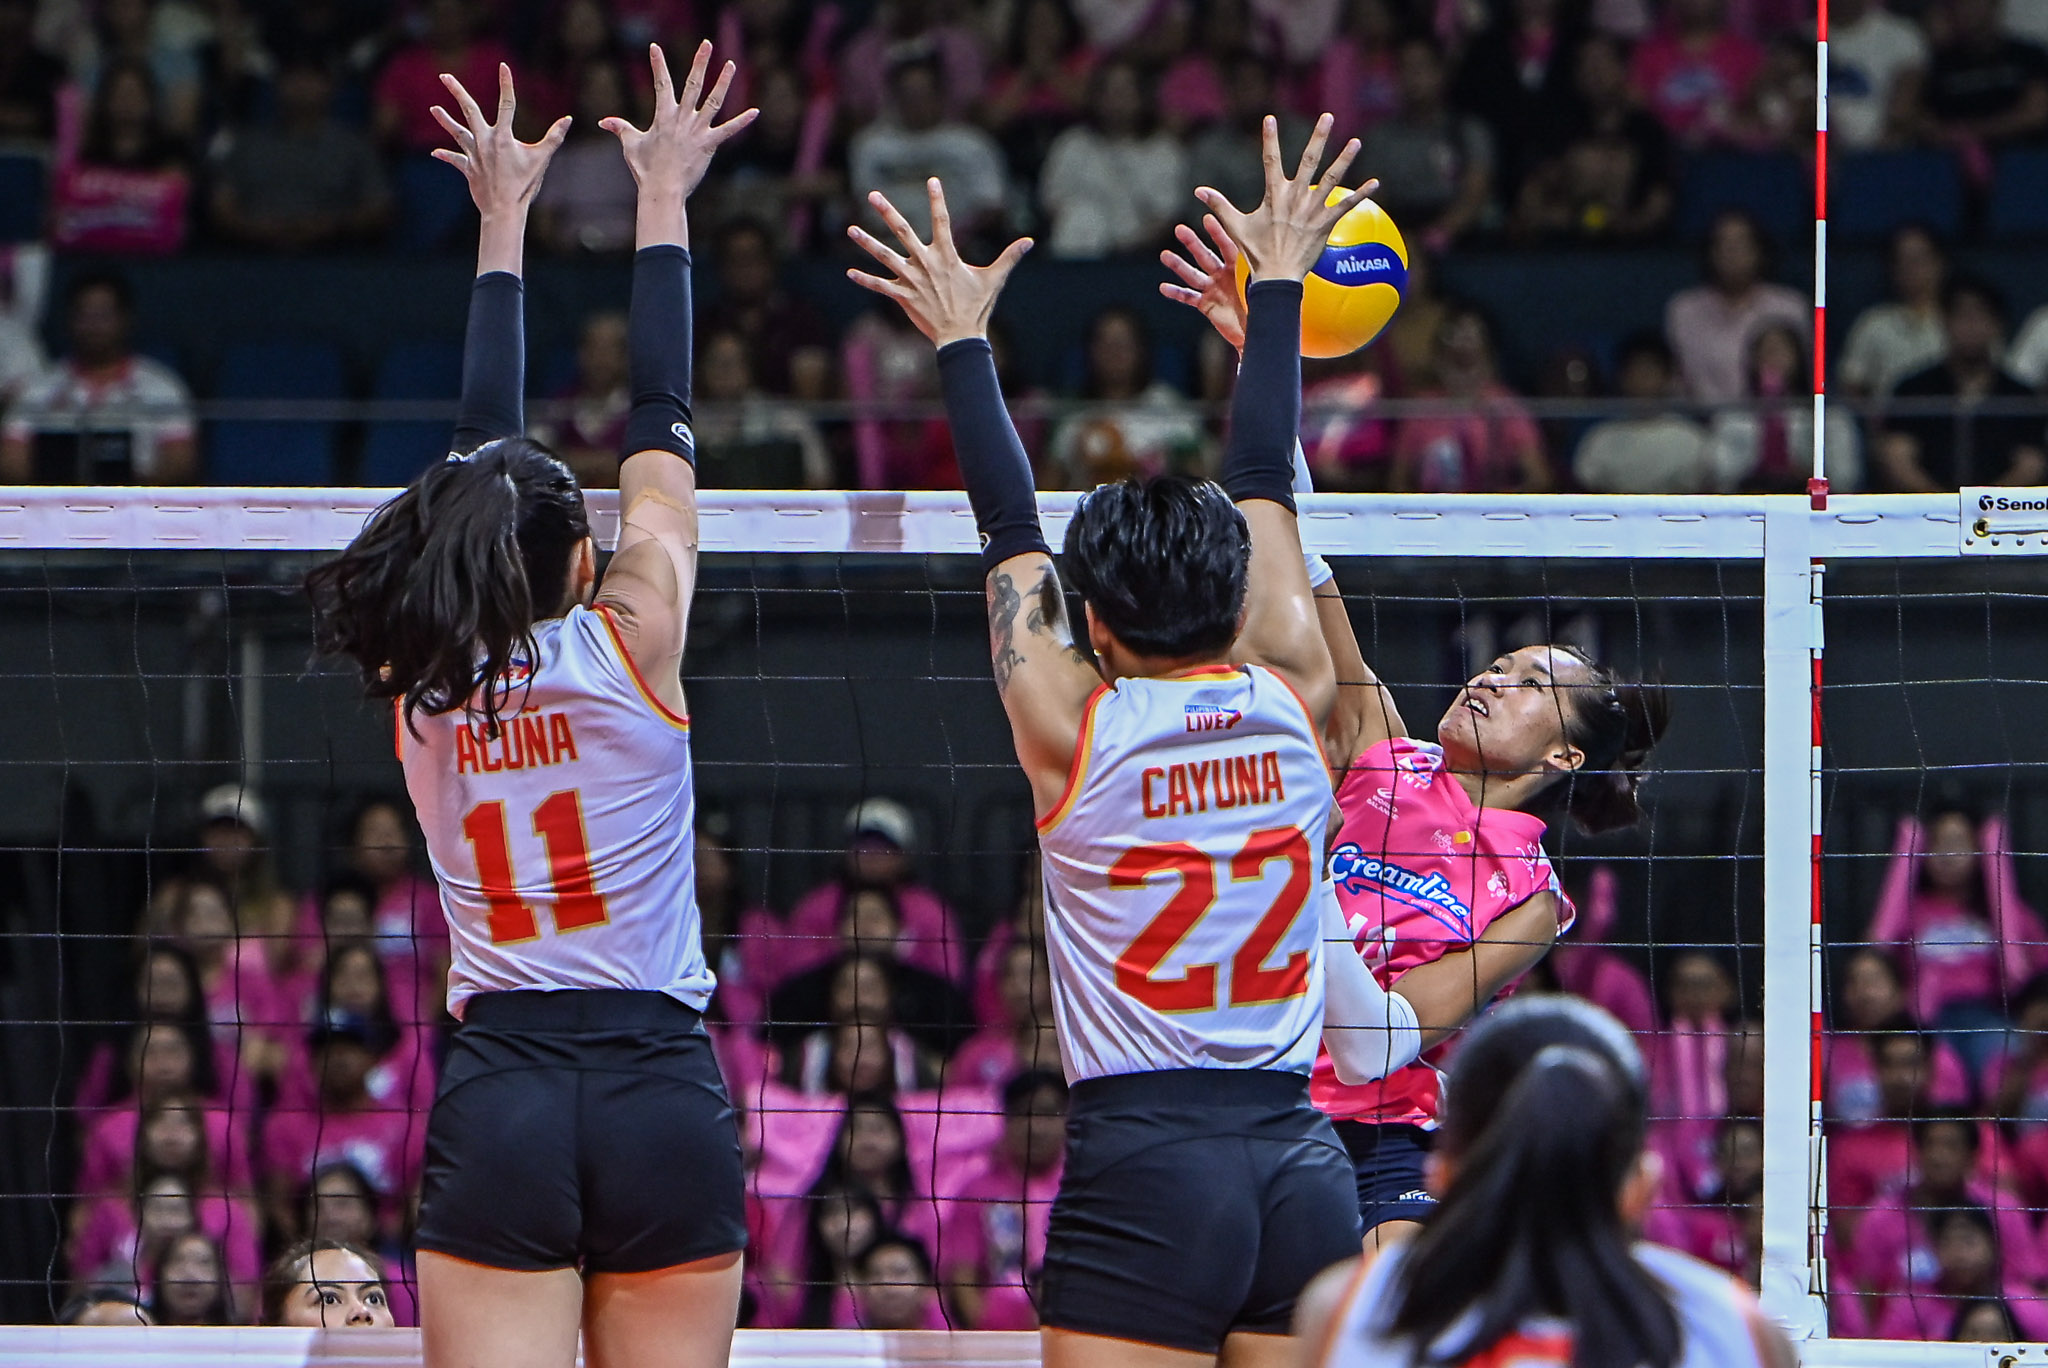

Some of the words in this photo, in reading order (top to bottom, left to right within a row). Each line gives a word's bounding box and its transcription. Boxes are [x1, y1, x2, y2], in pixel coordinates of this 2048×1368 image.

[1996, 496, 2048, 511] Seno
[456, 705, 579, 775] ACUÑA
[1185, 713, 1224, 733] LIVE
[1141, 750, 1286, 820] CAYUNA
[462, 788, 610, 946] 11
[1328, 844, 1469, 918] Creamline
[1107, 824, 1312, 1015] 22
